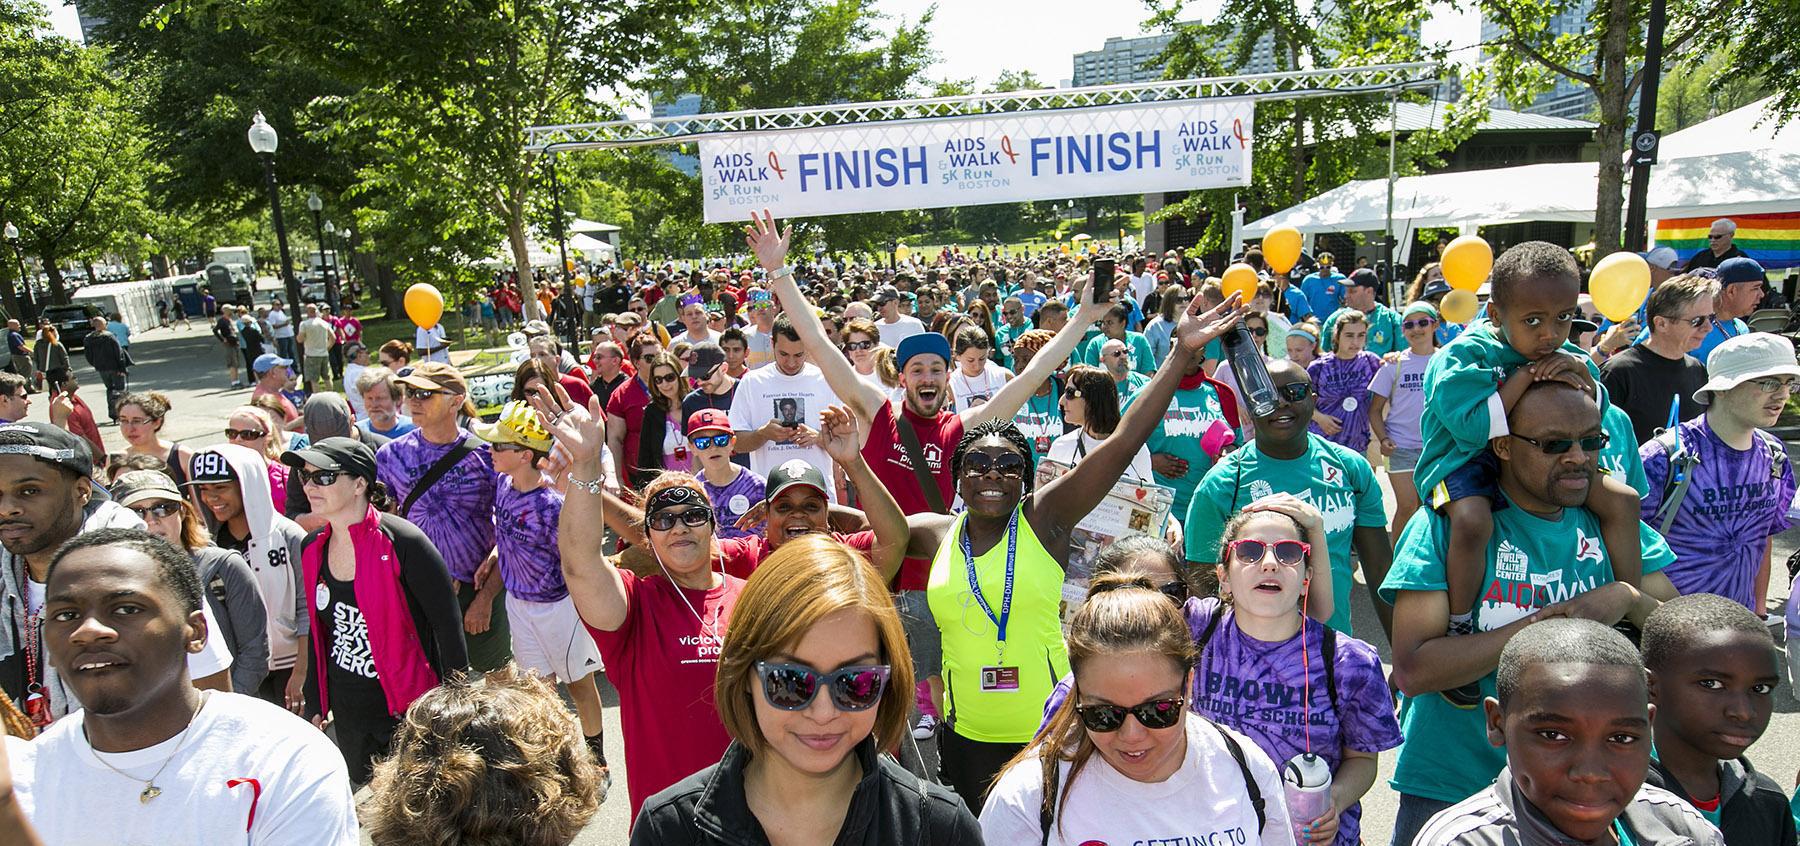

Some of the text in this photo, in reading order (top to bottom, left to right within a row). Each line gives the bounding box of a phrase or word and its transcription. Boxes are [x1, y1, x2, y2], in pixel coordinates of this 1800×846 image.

[1178, 120, 1218, 136] AIDS
[944, 137, 985, 153] AIDS
[1183, 135, 1231, 152] WALK
[713, 152, 753, 168] AIDS
[950, 151, 1001, 167] WALK
[1030, 130, 1161, 176] FINISH
[799, 145, 928, 192] FINISH
[1175, 155, 1191, 170] 5K
[1190, 164, 1239, 176] BOSTON
[718, 167, 769, 183] WALK
[942, 170, 958, 185] 5K
[958, 178, 1010, 190] BOSTON
[712, 186, 728, 200] 5K
[729, 193, 780, 206] BOSTON
[702, 412, 713, 423] C
[1703, 480, 1776, 503] BROWN
[1693, 503, 1741, 516] MIDDLE
[1497, 551, 1519, 563] LOWELL
[1496, 562, 1520, 572] HEALTH
[1495, 570, 1526, 581] CENTER
[1002, 576, 1013, 614] DPH-DMH
[331, 645, 380, 679] FIERC
[1196, 696, 1329, 726] MIDDLE SCHOOL
[1224, 827, 1246, 846] TO
